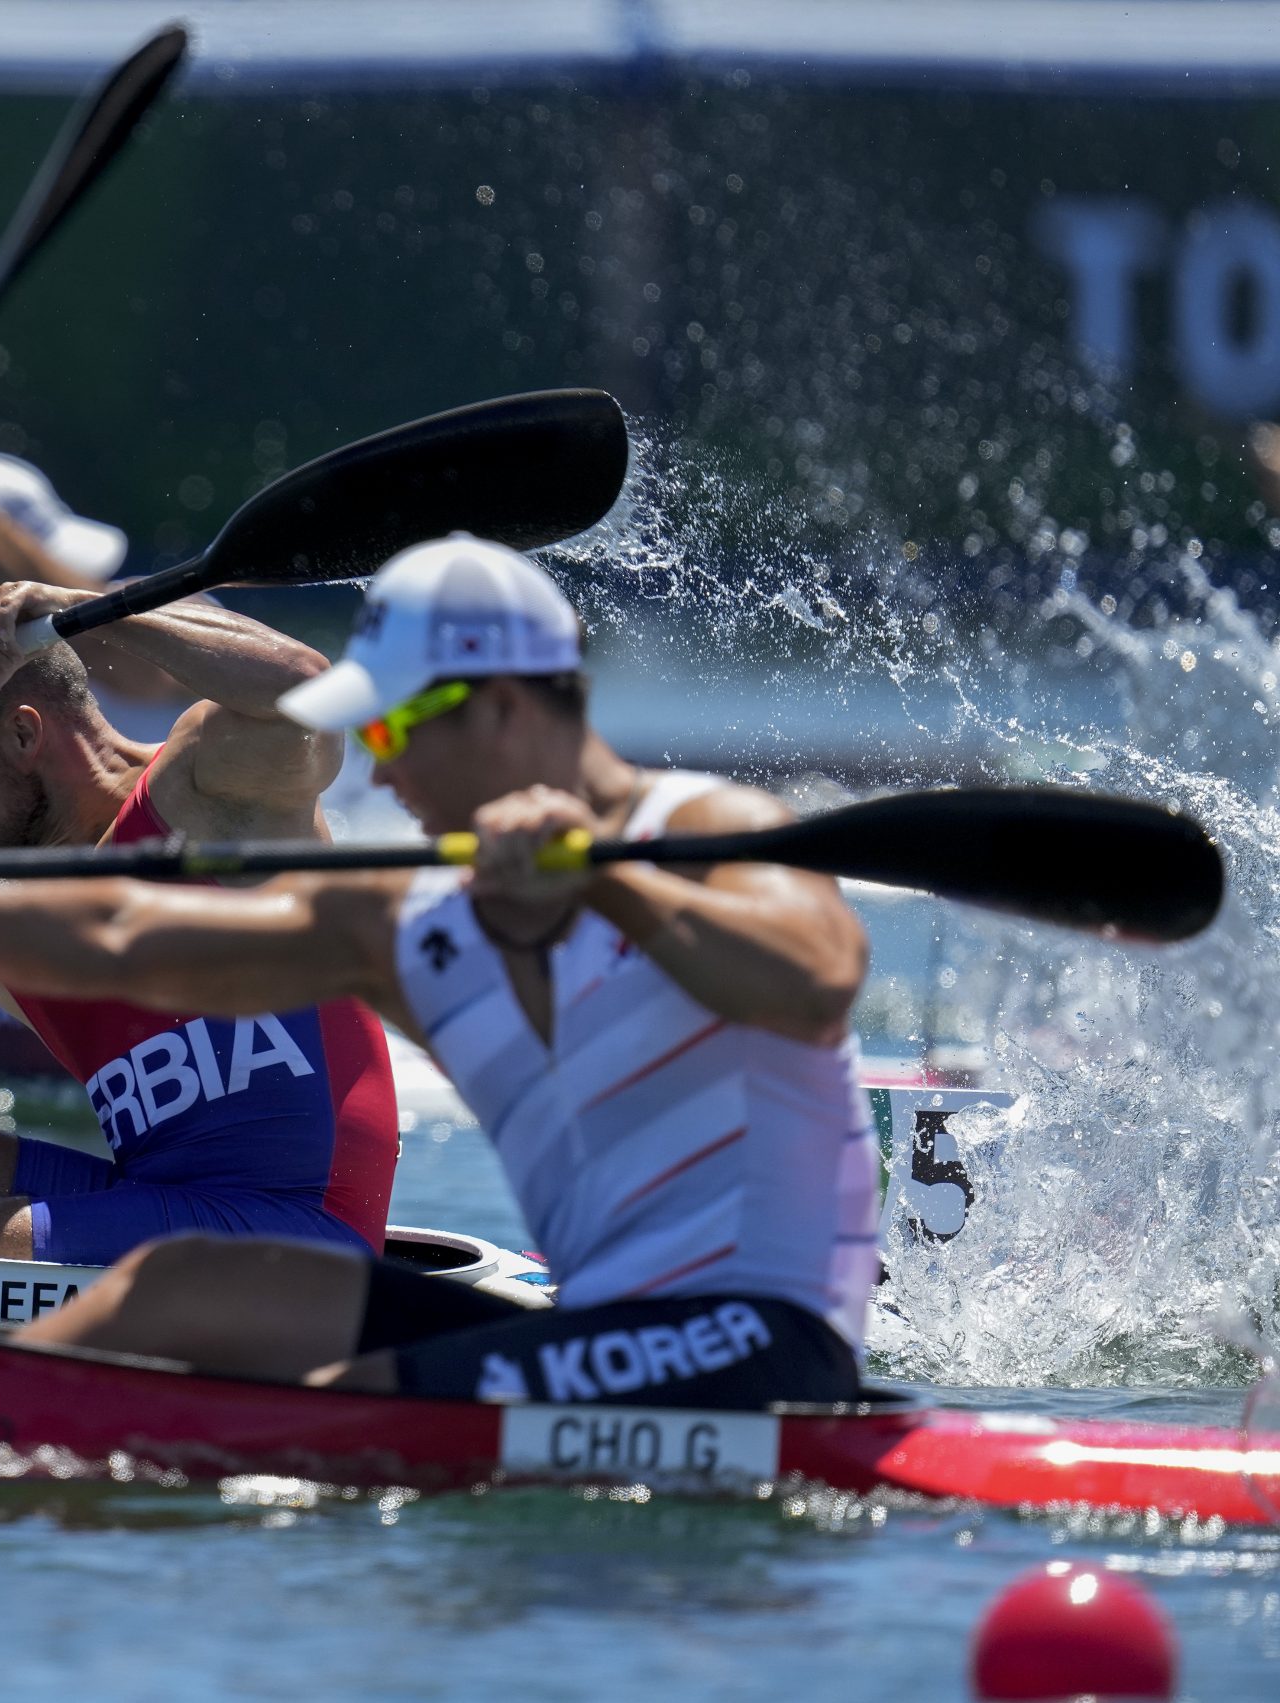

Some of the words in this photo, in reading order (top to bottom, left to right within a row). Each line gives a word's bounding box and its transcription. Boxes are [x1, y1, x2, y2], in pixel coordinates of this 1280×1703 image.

[908, 1110, 975, 1246] 5
[538, 1301, 772, 1402] KOREA
[550, 1415, 662, 1471] CHO
[686, 1421, 719, 1473] G
